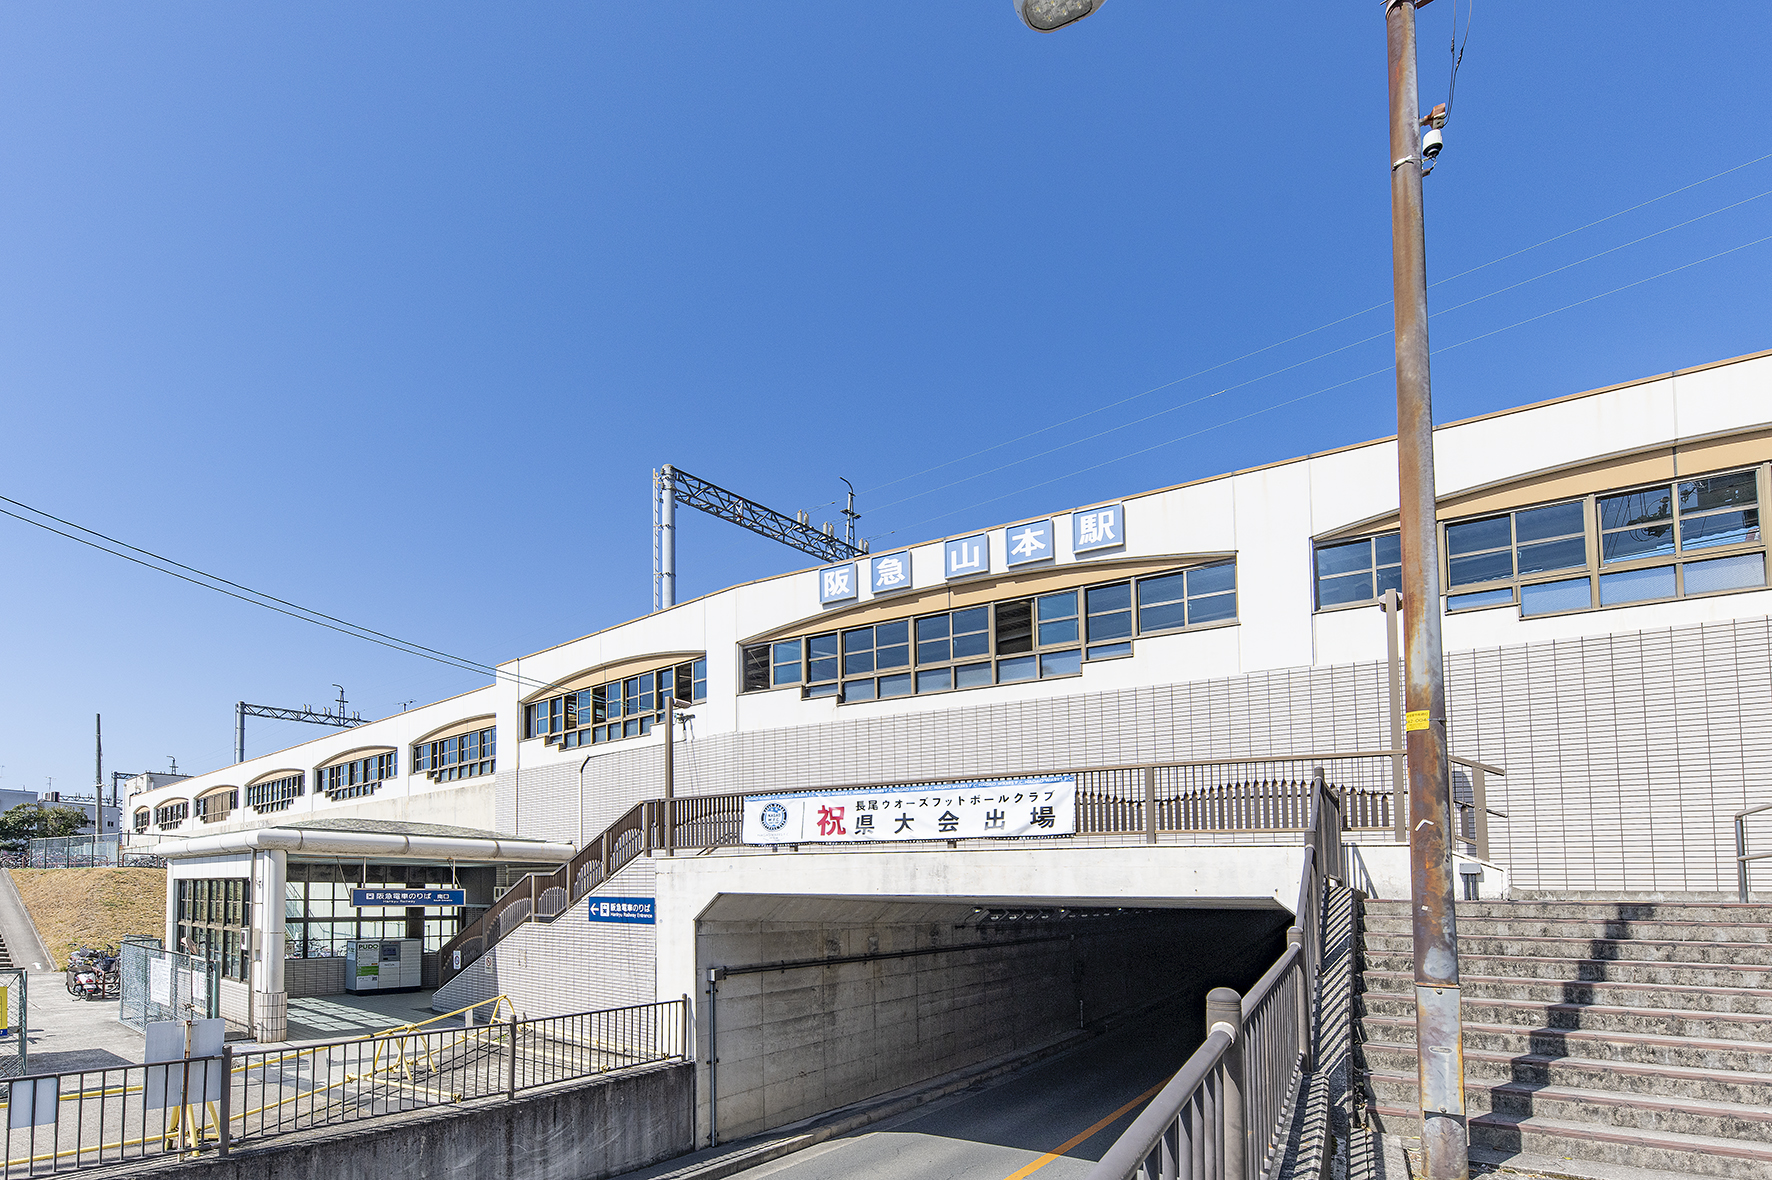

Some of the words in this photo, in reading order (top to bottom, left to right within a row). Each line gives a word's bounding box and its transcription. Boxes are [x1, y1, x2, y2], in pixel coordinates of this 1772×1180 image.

[823, 511, 1116, 597] 阪急山本駅
[816, 804, 847, 836] 祝
[854, 806, 1056, 836] 県大会出場
[376, 892, 432, 900] 阪急電車のりば
[610, 902, 651, 912] 阪急電車のりば
